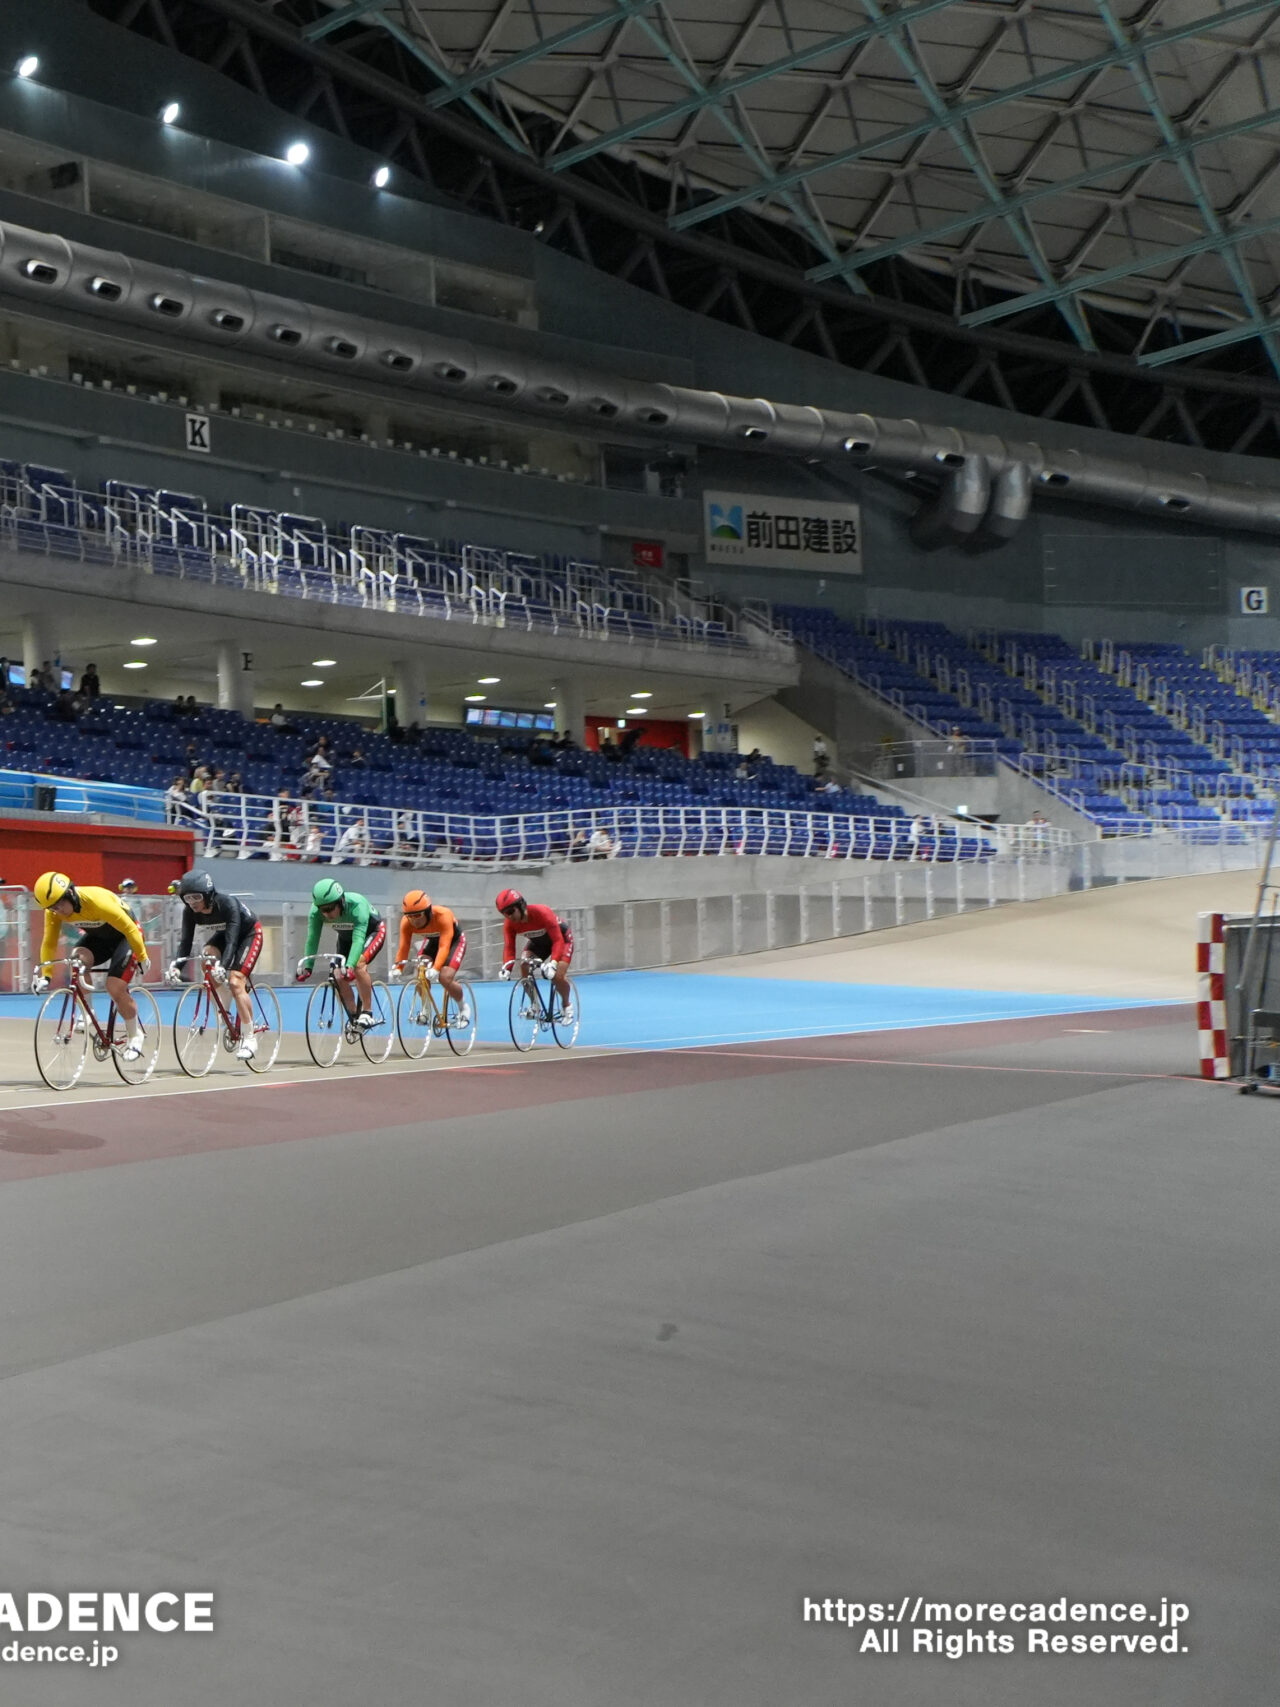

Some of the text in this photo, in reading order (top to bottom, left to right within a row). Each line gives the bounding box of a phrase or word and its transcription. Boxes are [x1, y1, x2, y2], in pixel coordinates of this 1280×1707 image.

[189, 418, 208, 449] K
[746, 511, 858, 554] 前田建設
[1246, 590, 1263, 610] G
